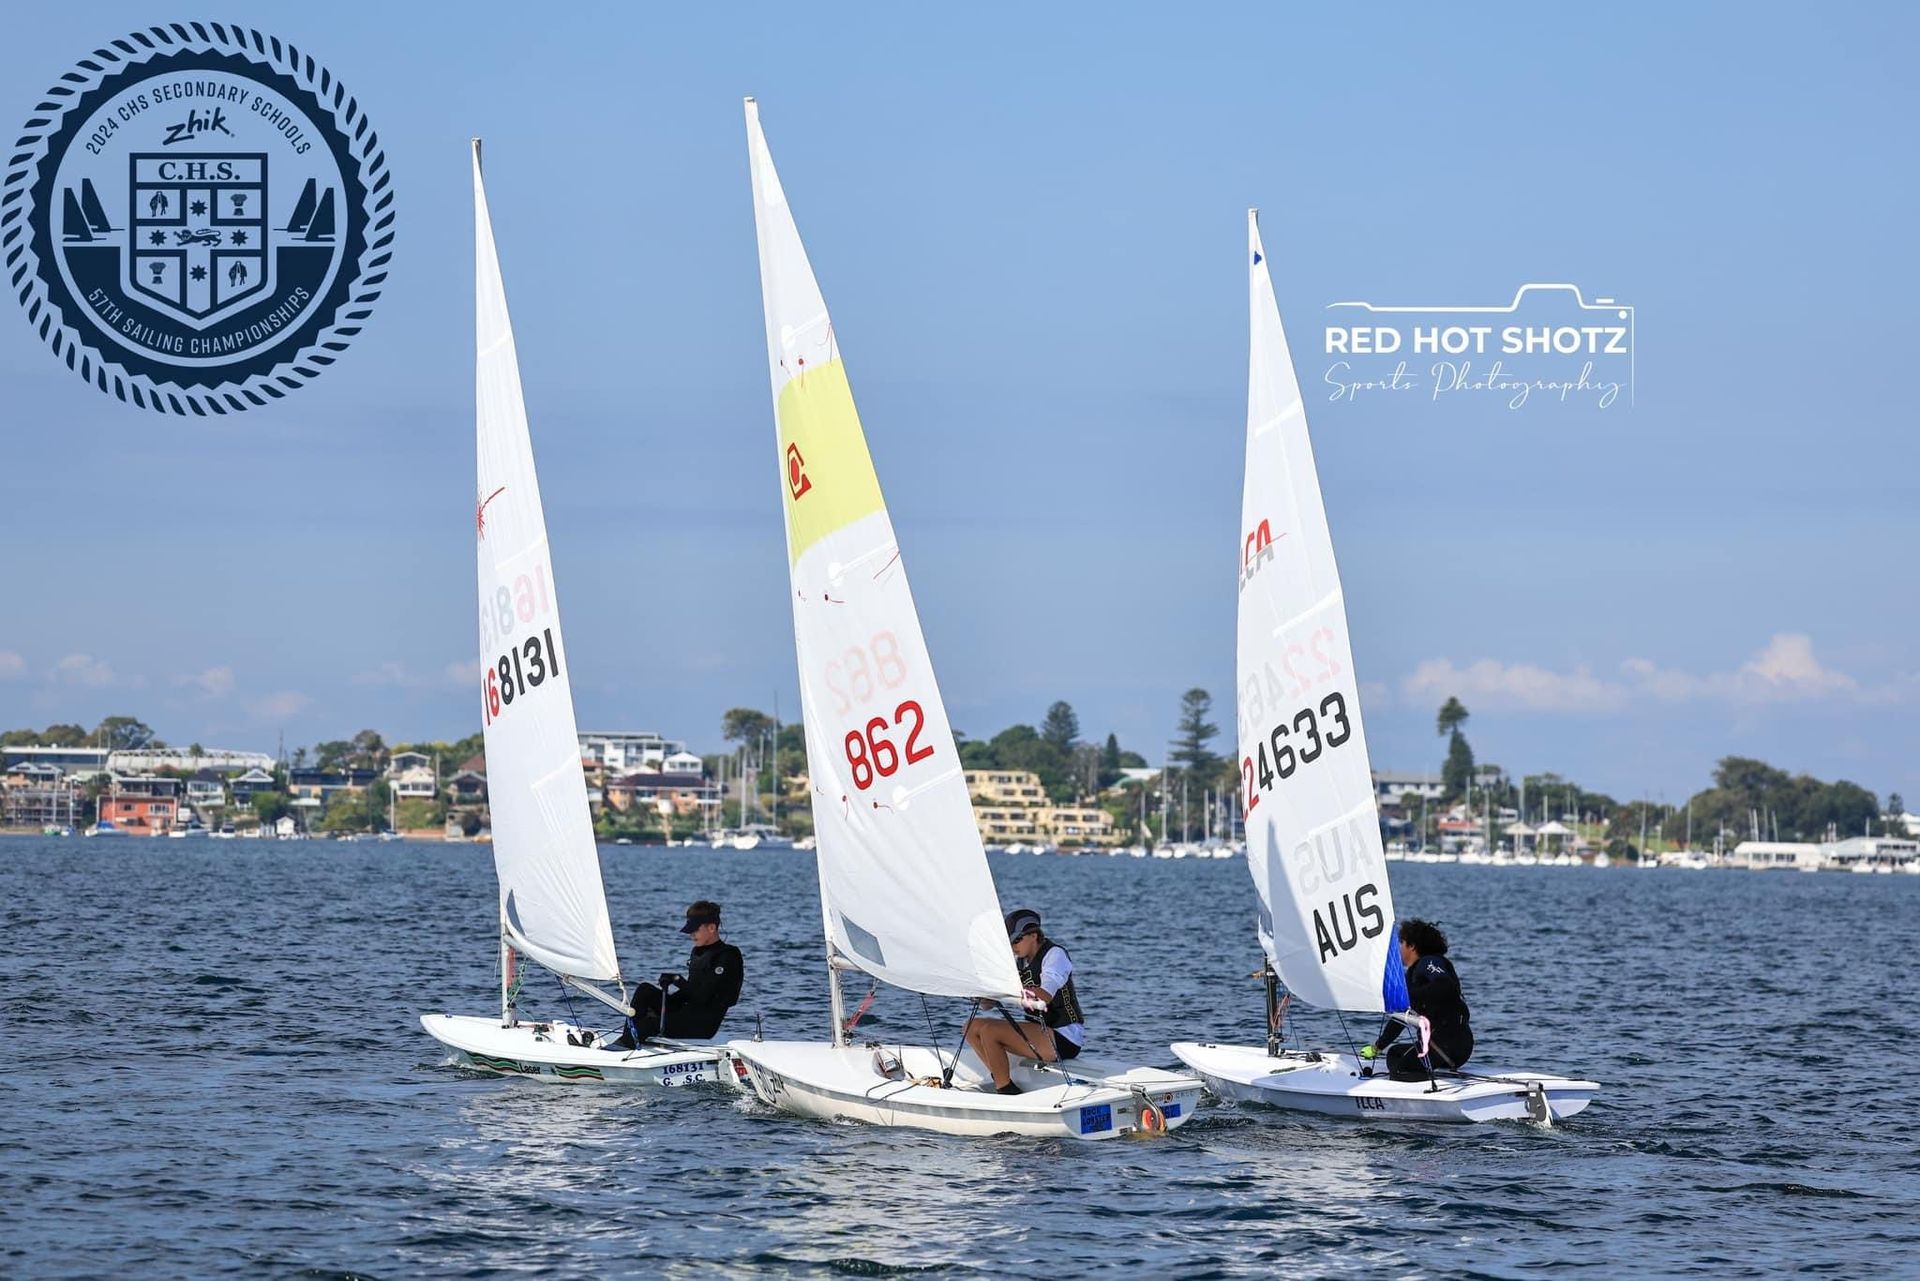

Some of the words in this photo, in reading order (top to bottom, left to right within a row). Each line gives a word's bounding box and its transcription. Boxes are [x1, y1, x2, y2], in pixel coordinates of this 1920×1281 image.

[483, 628, 559, 726] 168131
[844, 700, 934, 790] 862
[1313, 883, 1384, 964] AUS
[663, 1062, 704, 1075] 168131
[1355, 1096, 1385, 1110] ILCA
